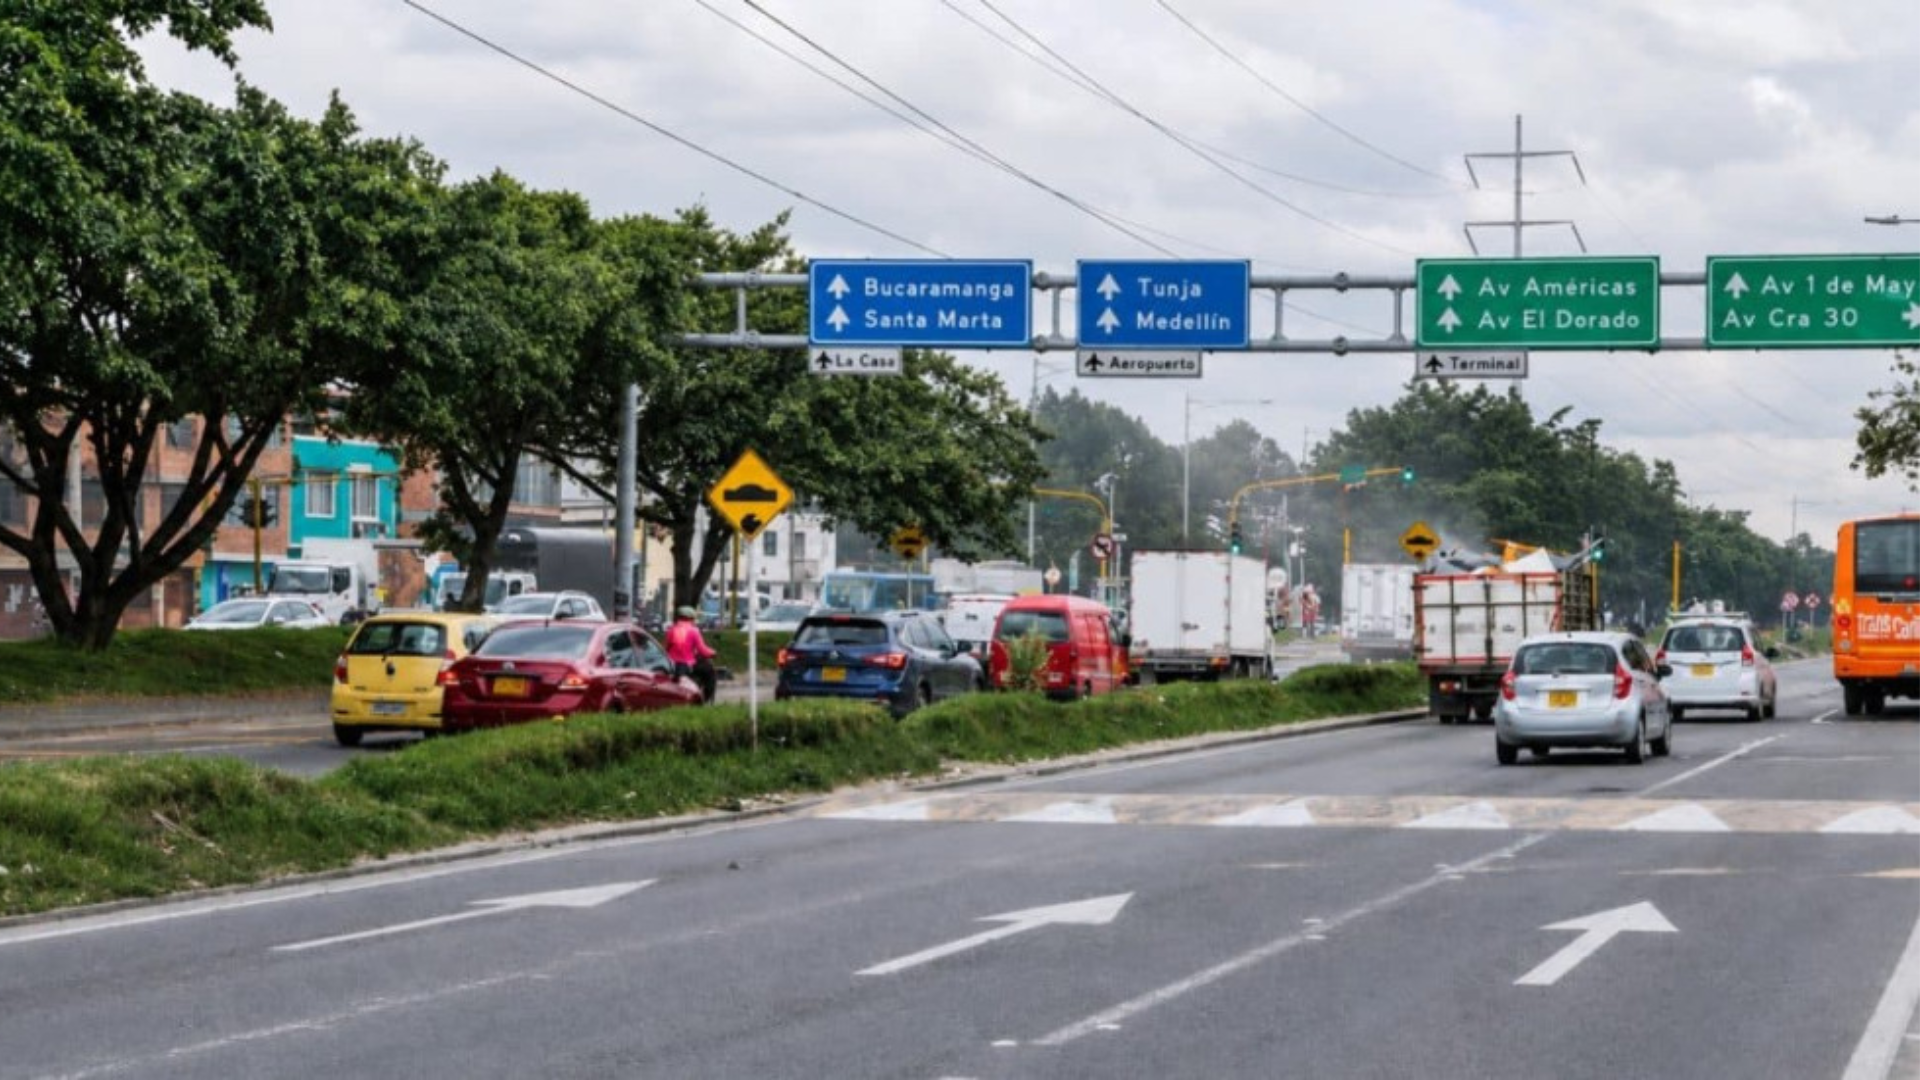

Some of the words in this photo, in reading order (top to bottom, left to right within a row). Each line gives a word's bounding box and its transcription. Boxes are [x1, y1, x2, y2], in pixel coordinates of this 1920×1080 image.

[865, 277, 1013, 301] Bucaramanga
[1137, 277, 1202, 302] Tunja
[1478, 277, 1510, 296] Av
[1523, 276, 1637, 296] Américas
[1761, 275, 1793, 294] Av
[1806, 274, 1814, 294] 1
[1826, 275, 1854, 294] de
[865, 310, 927, 328] Santa
[938, 310, 1002, 328] Marta
[1137, 309, 1230, 330] Medellín
[1478, 310, 1510, 329] Av
[1523, 309, 1545, 329] El
[1556, 309, 1640, 329] Dorado
[1723, 308, 1756, 328] Av
[1768, 307, 1810, 328] Cra
[1824, 307, 1858, 327] 30
[836, 354, 853, 367] La
[860, 353, 895, 368] Casa
[1109, 356, 1195, 372] Aeropuerto
[1448, 355, 1520, 370] Terminal
